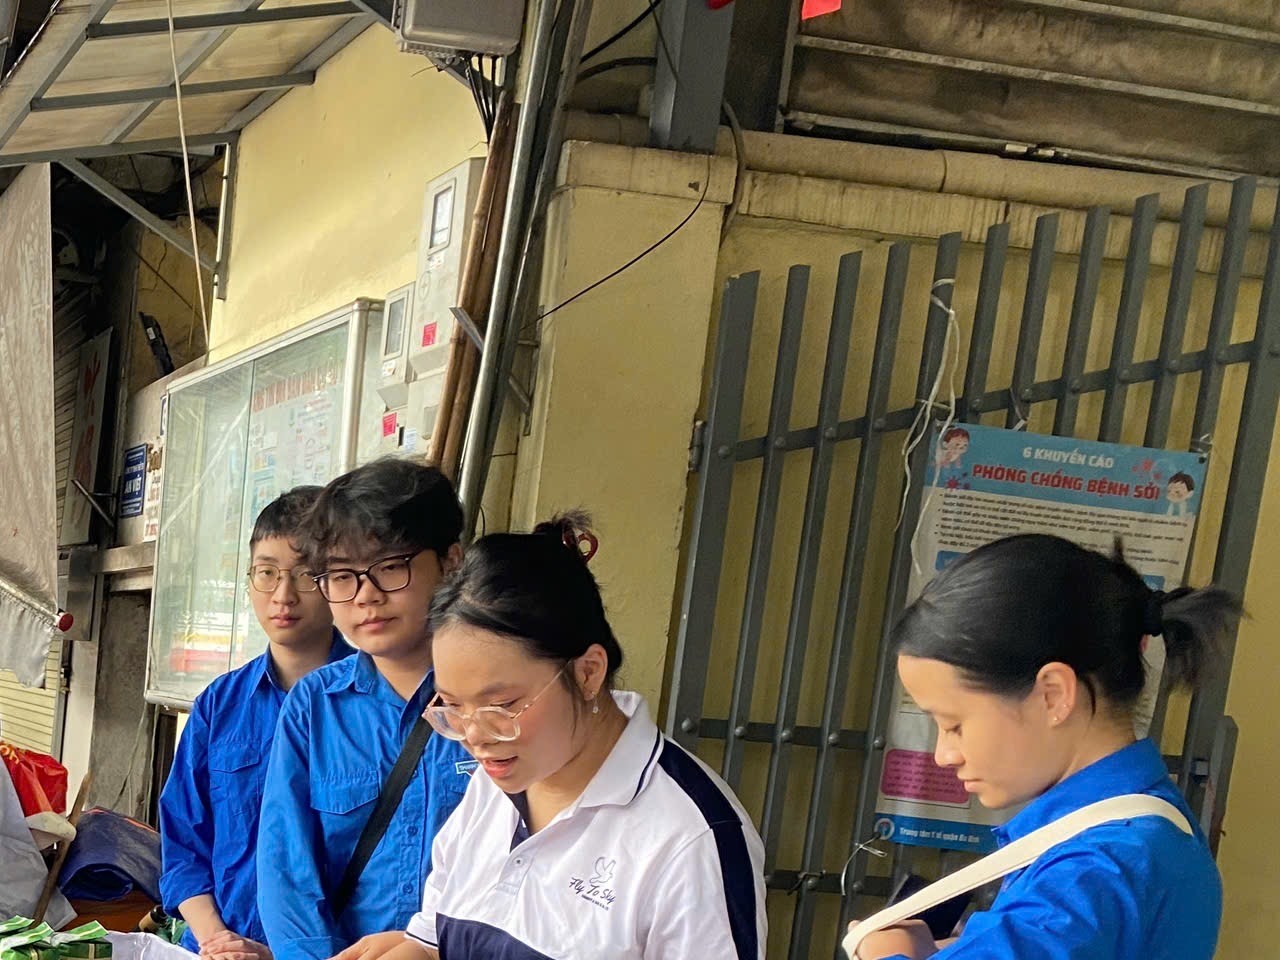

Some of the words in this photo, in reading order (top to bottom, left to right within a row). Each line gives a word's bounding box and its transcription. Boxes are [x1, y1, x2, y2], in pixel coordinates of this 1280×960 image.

[1022, 447, 1033, 458] 6
[1034, 448, 1087, 466] KHUYẾN
[1088, 454, 1115, 469] CÁO
[972, 463, 1027, 484] PHÒNG
[1030, 468, 1084, 492] CHỐNG
[1086, 476, 1130, 498] BỆNH
[1133, 481, 1161, 501] SỞI
[569, 877, 585, 894] Fly
[587, 884, 600, 897] To
[600, 888, 616, 905] Sky
